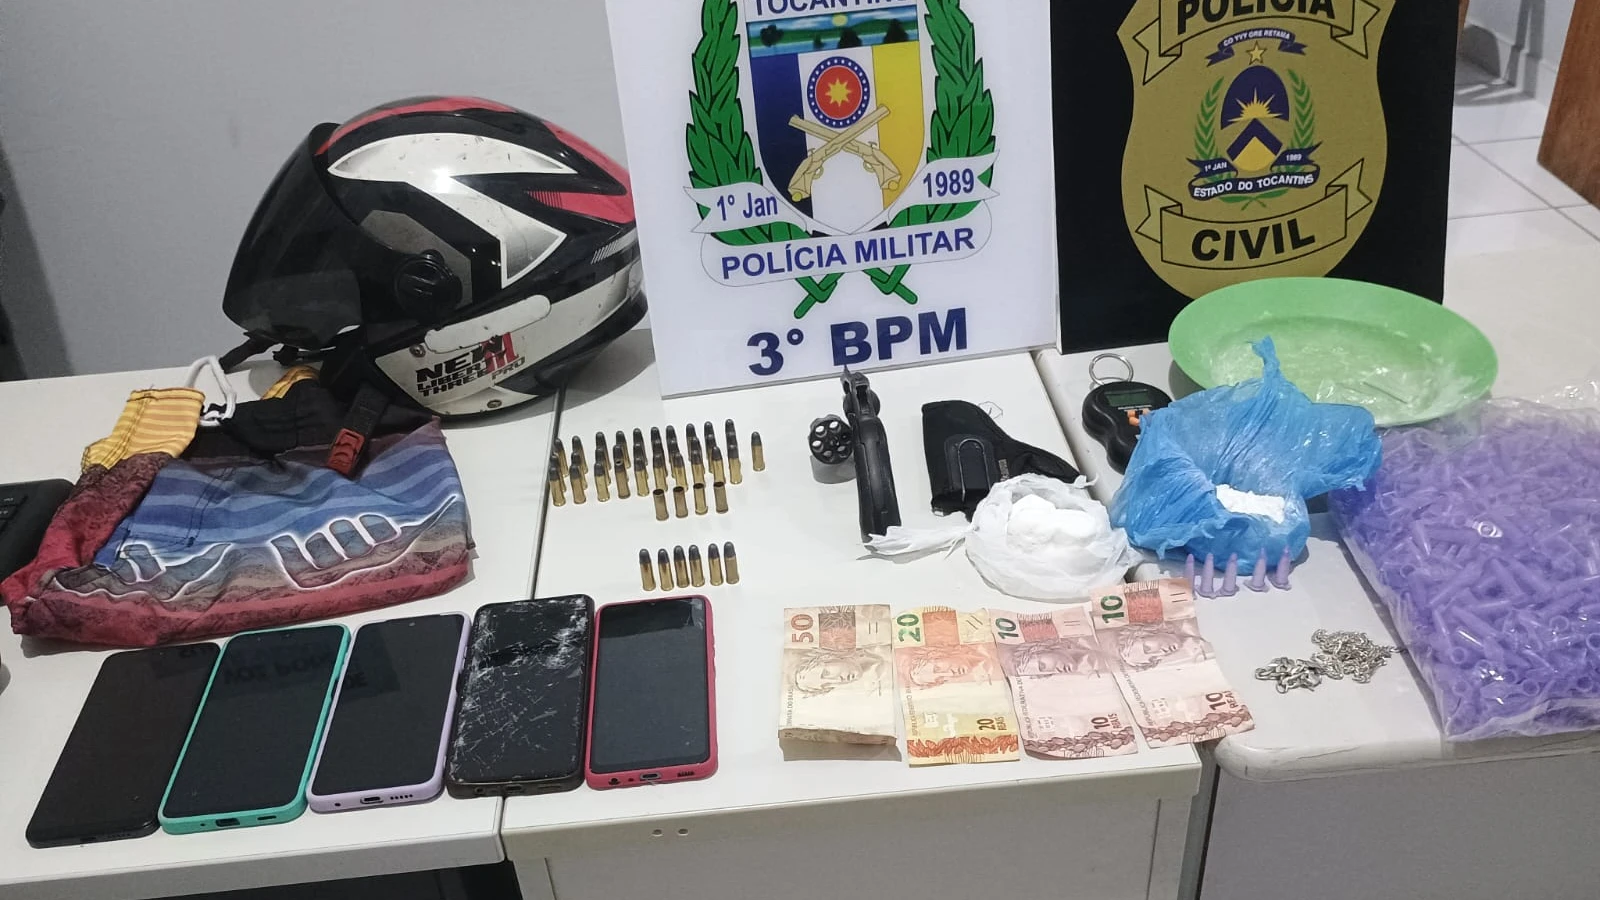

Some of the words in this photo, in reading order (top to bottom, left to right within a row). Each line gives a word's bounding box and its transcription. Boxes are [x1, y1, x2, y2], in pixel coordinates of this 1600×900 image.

[1212, 162, 1228, 171] JAN
[922, 168, 975, 198] 1989
[1193, 182, 1233, 198] ESTADO
[1238, 181, 1253, 191] DO
[1256, 174, 1315, 189] TOCANTINS
[743, 193, 778, 219] Jan
[1191, 218, 1316, 262] CIVIL
[721, 244, 847, 280] POLÍCIA
[854, 227, 976, 265] MILITAR
[830, 307, 968, 367] BPM
[1100, 595, 1125, 624] 10
[790, 613, 814, 644] 50
[896, 613, 921, 642] 20
[995, 617, 1020, 641] 10
[1205, 692, 1227, 711] 10
[1222, 690, 1239, 709] REAI
[976, 718, 996, 731] 20
[1091, 716, 1110, 730] 10
[1108, 713, 1122, 729] REAIS
